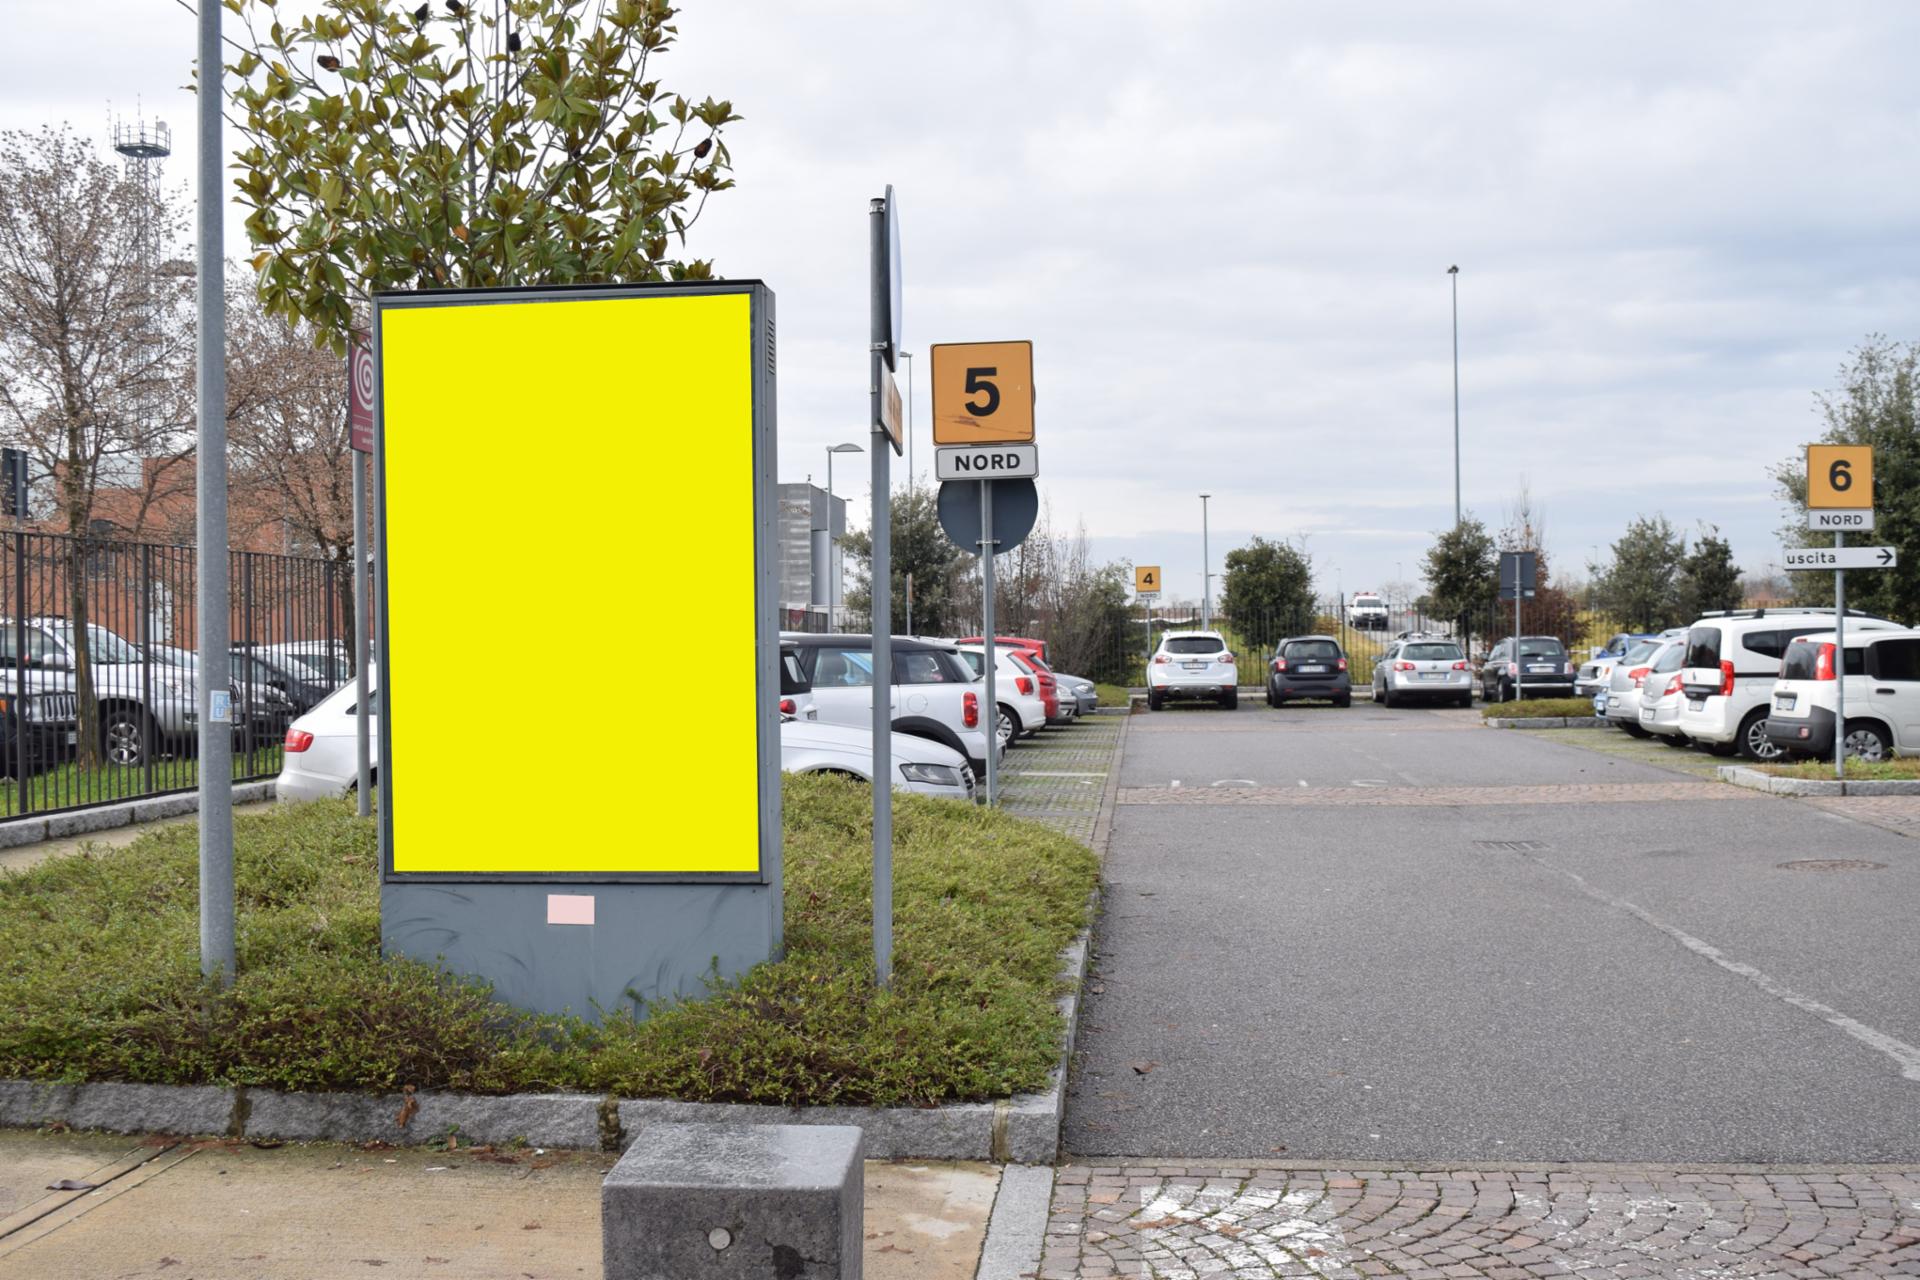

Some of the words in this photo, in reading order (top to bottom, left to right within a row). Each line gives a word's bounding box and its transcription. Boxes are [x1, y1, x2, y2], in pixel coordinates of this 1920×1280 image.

[965, 367, 1000, 416] 5
[955, 453, 1020, 472] NORD
[1829, 460, 1852, 491] 6
[1820, 514, 1863, 525] NORD
[1786, 552, 1836, 565] uscita
[1143, 572, 1154, 585] 4
